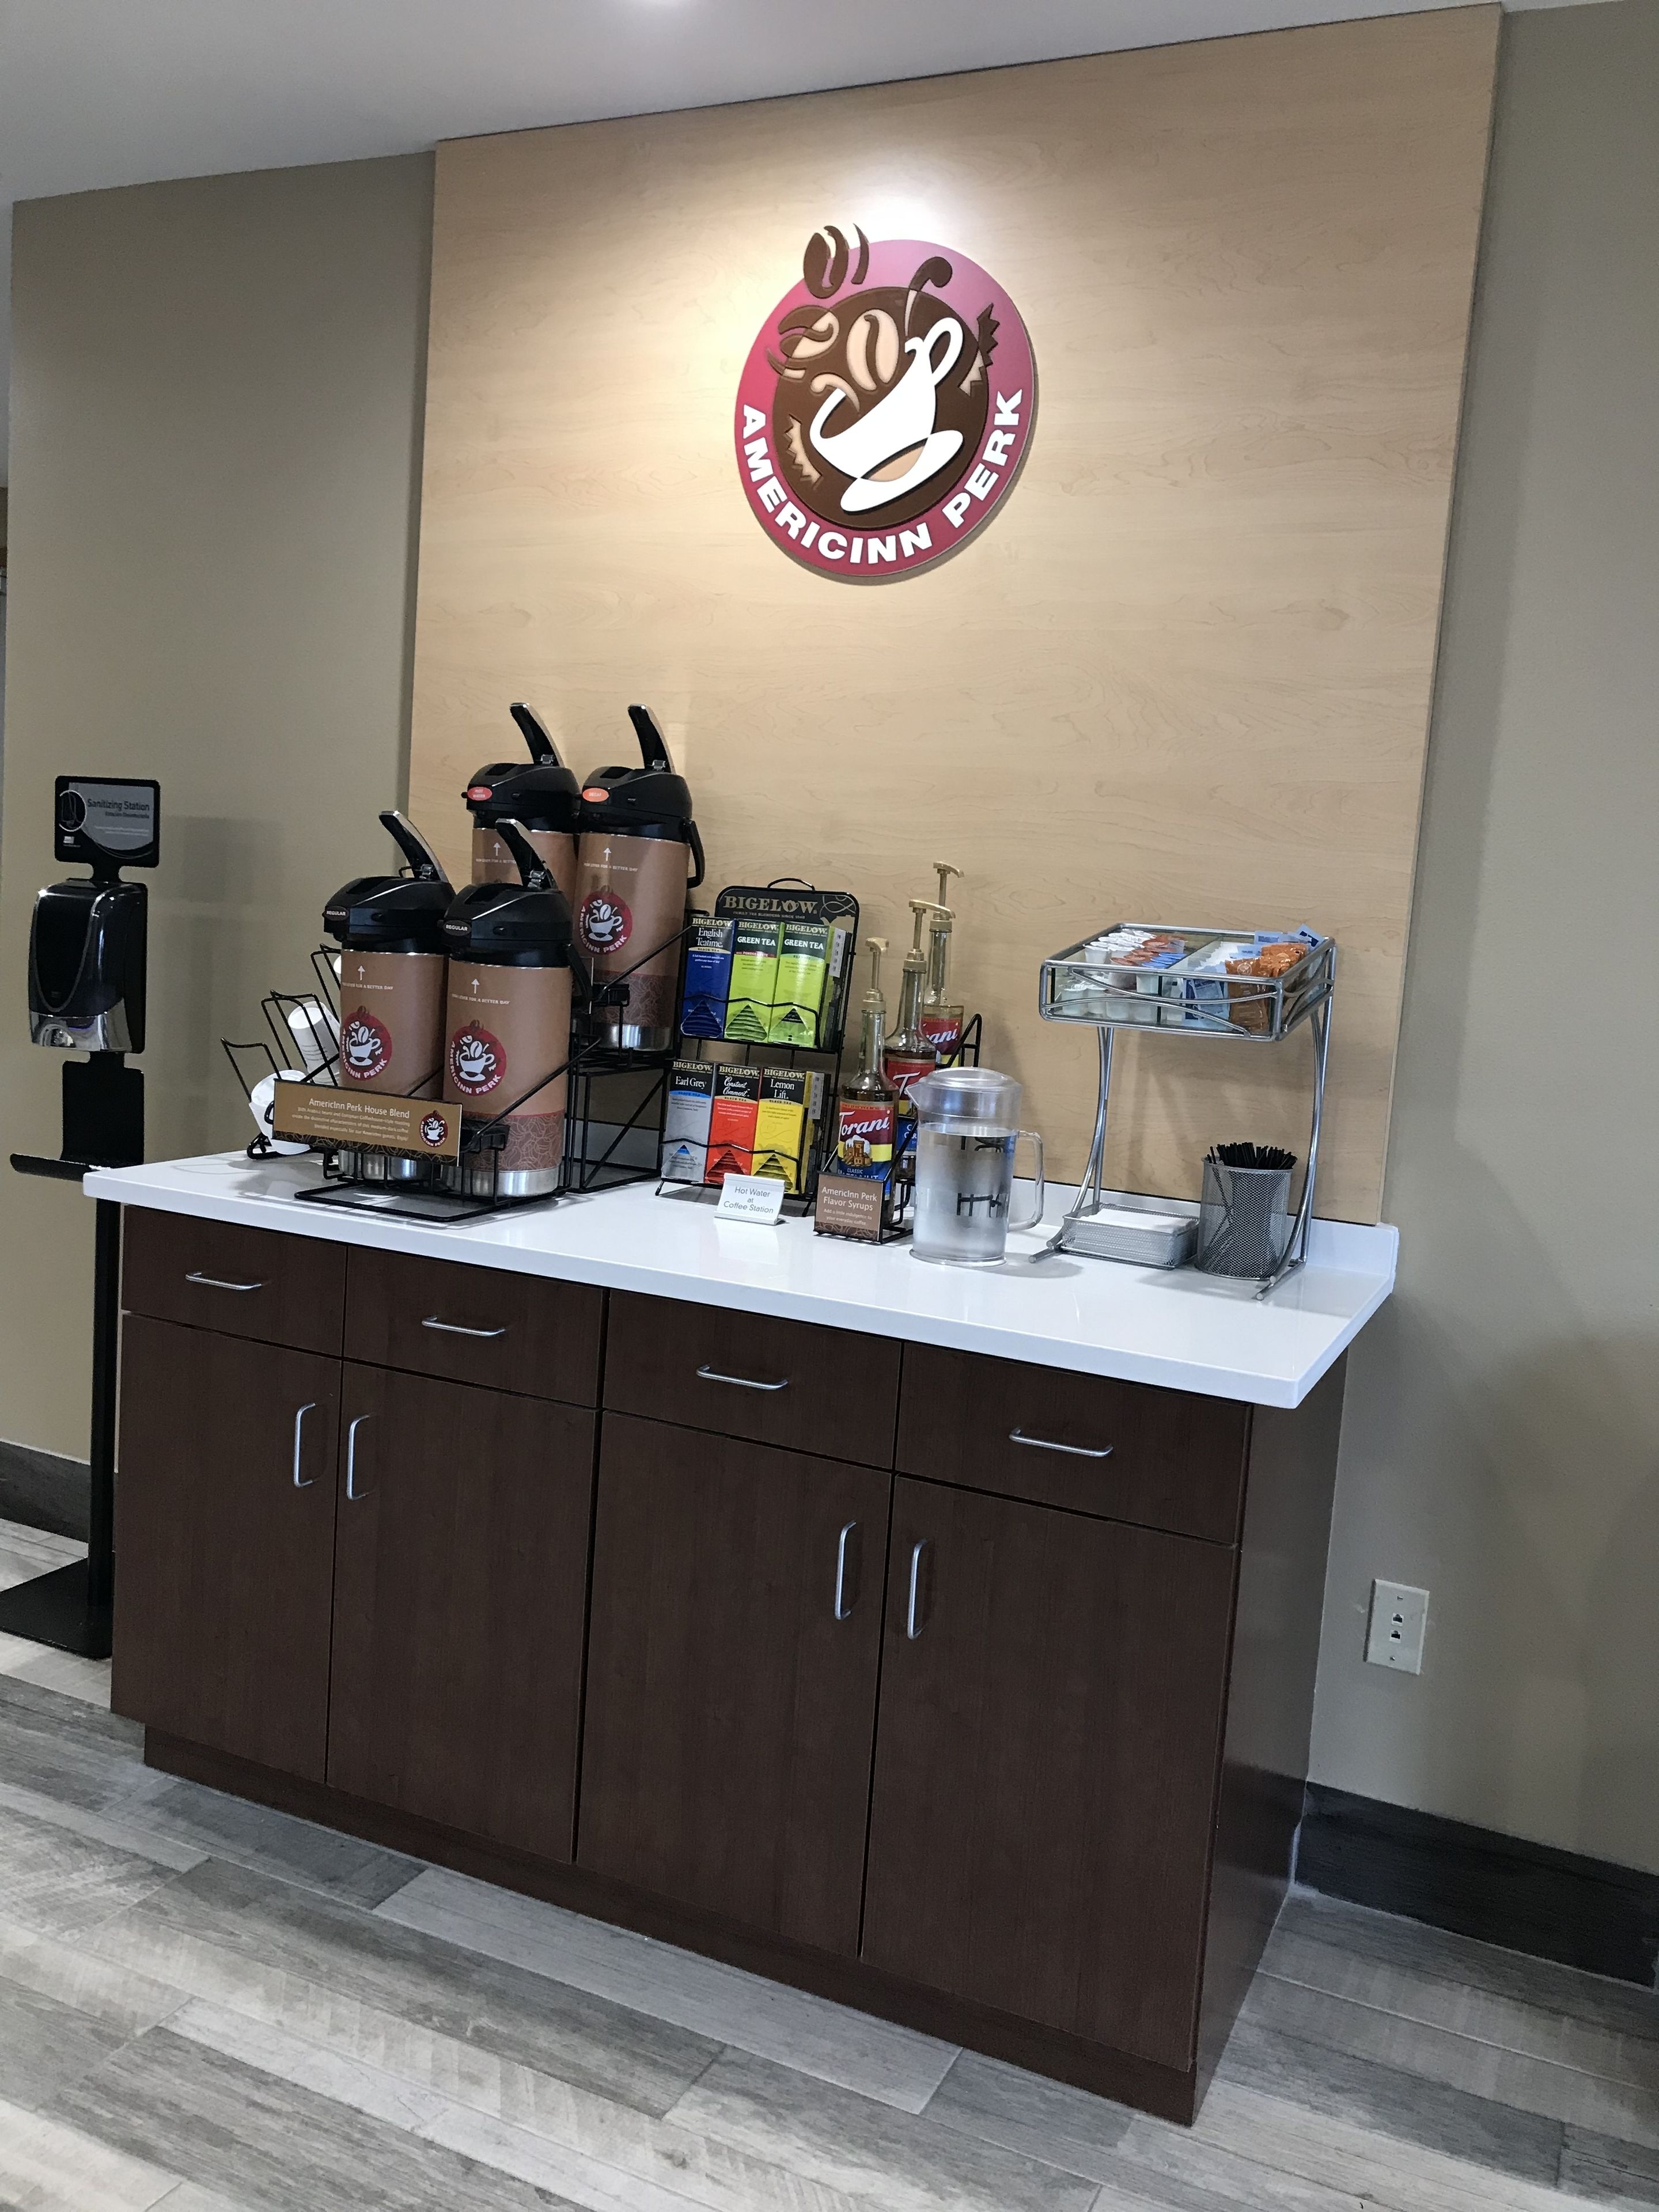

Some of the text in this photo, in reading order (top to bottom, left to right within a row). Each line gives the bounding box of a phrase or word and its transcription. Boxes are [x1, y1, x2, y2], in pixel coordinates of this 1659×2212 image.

[744, 389, 1023, 564] AMERICINN PERK
[88, 798, 150, 811] Sanitizing Station
[723, 896, 818, 914] BIGELOW
[692, 918, 732, 927] BIGELOW
[738, 921, 779, 931] BIGELOW
[579, 906, 627, 953] AMERICINN PERK
[698, 927, 723, 938] English
[786, 924, 828, 934] BIGELOW
[696, 937, 722, 948] Teatime
[737, 936, 776, 946] GREEN TEA
[784, 939, 808, 948] GREEN
[363, 1059, 388, 1078] PERK
[450, 1041, 502, 1094] AMERICINN PERK
[673, 1061, 713, 1071] BIGELOW
[719, 1066, 759, 1077] BIGELOW
[764, 1068, 805, 1079] BIGELOW
[675, 1076, 705, 1089] Earl Grey
[770, 1079, 794, 1090] Lemon
[774, 1089, 786, 1099] Lift
[309, 1098, 410, 1119] AmericInn Perk House Blend
[839, 1110, 891, 1137] Torani
[734, 1186, 771, 1198] Hot Water
[821, 1187, 877, 1202] AmericInn Perk
[724, 1200, 774, 1213] Coffee Station
[823, 1196, 873, 1211] Flavor Syrups
